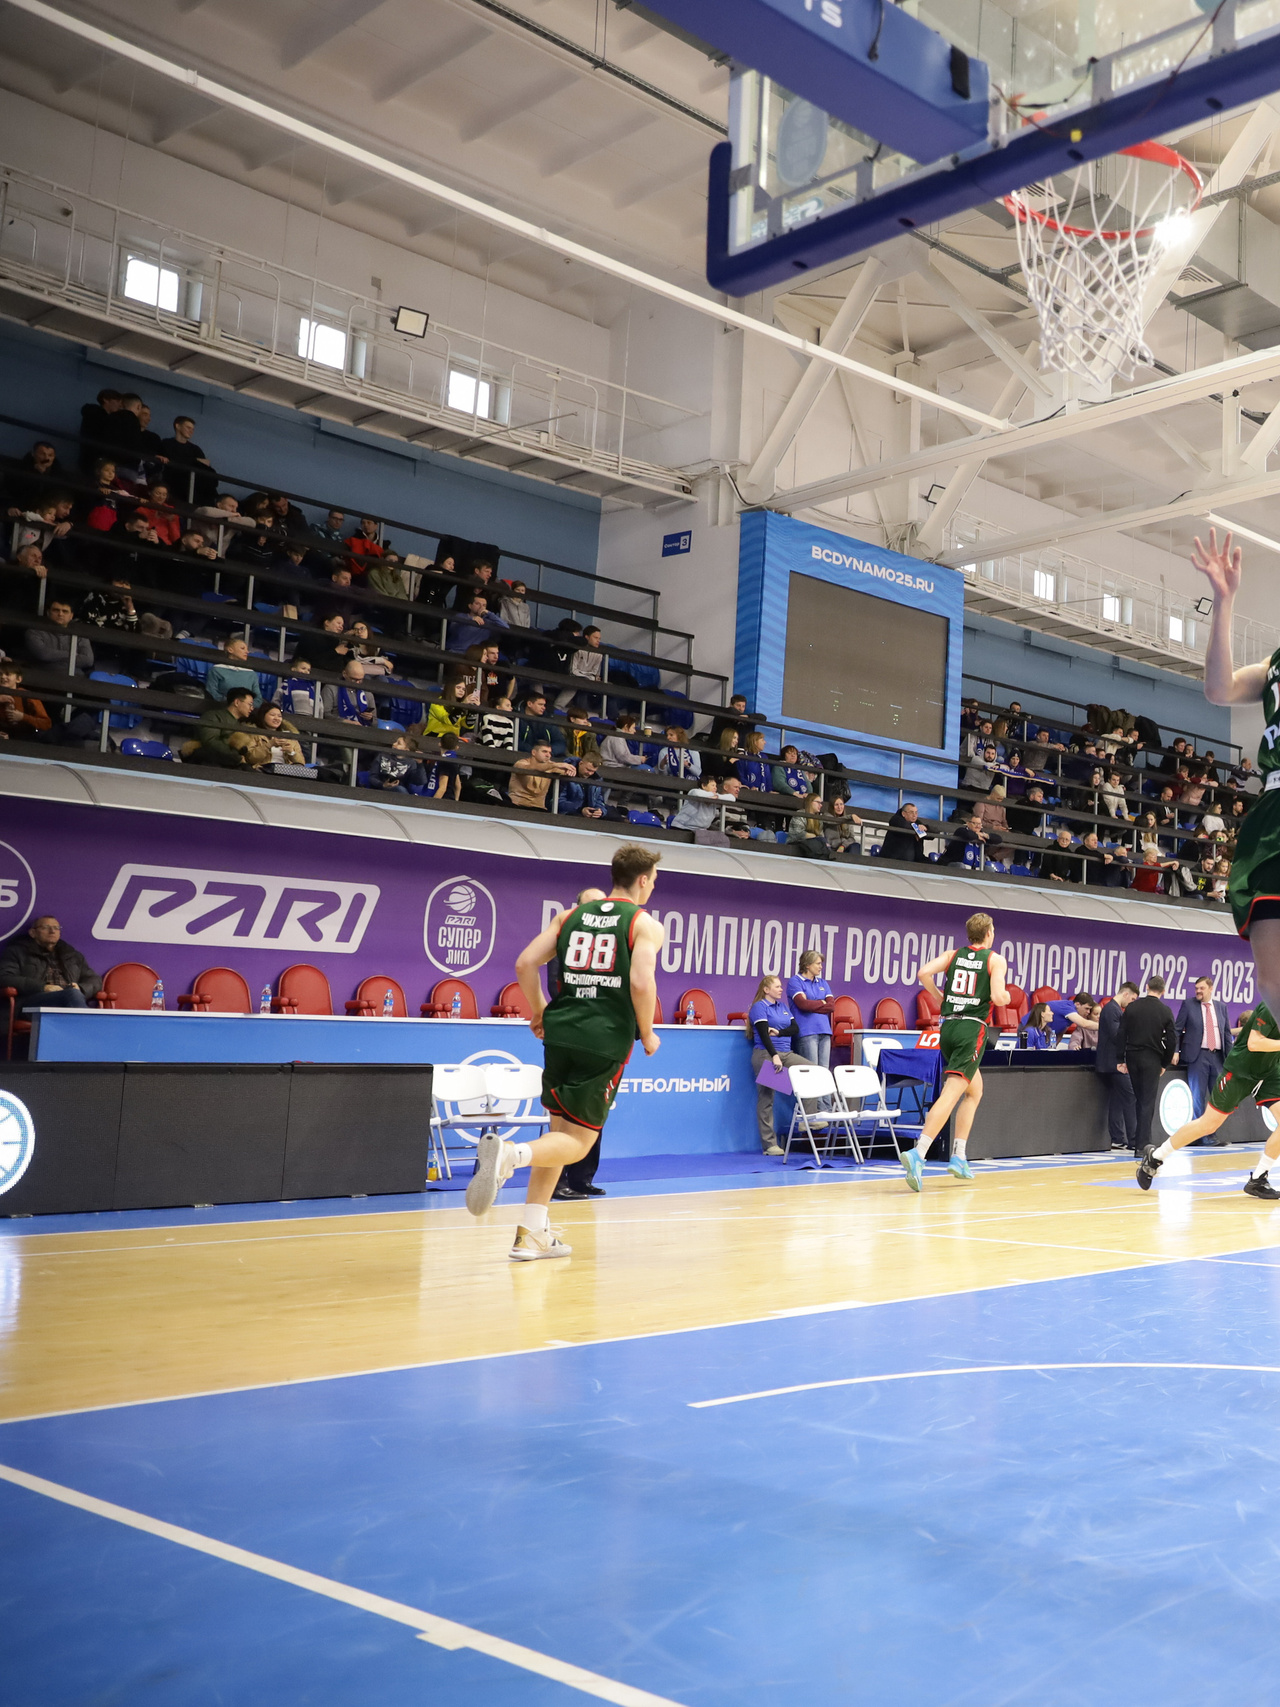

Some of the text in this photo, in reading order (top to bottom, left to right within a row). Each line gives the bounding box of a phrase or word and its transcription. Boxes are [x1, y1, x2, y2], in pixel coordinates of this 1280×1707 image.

[811, 545, 935, 594] BCDYNAMO25.RU
[107, 875, 366, 944] PARI
[446, 915, 476, 926] PARI
[437, 926, 482, 950] СУПЕР
[660, 910, 840, 982] ЕМПИОНАТ
[445, 949, 470, 966] ЛИГА
[564, 930, 618, 972] 88
[564, 972, 622, 988] АСНОДАРСКИЙ
[576, 986, 597, 998] КРАЙ
[951, 969, 978, 996] 81
[618, 1075, 731, 1093] ЕТБОЛЬНЫЙ
